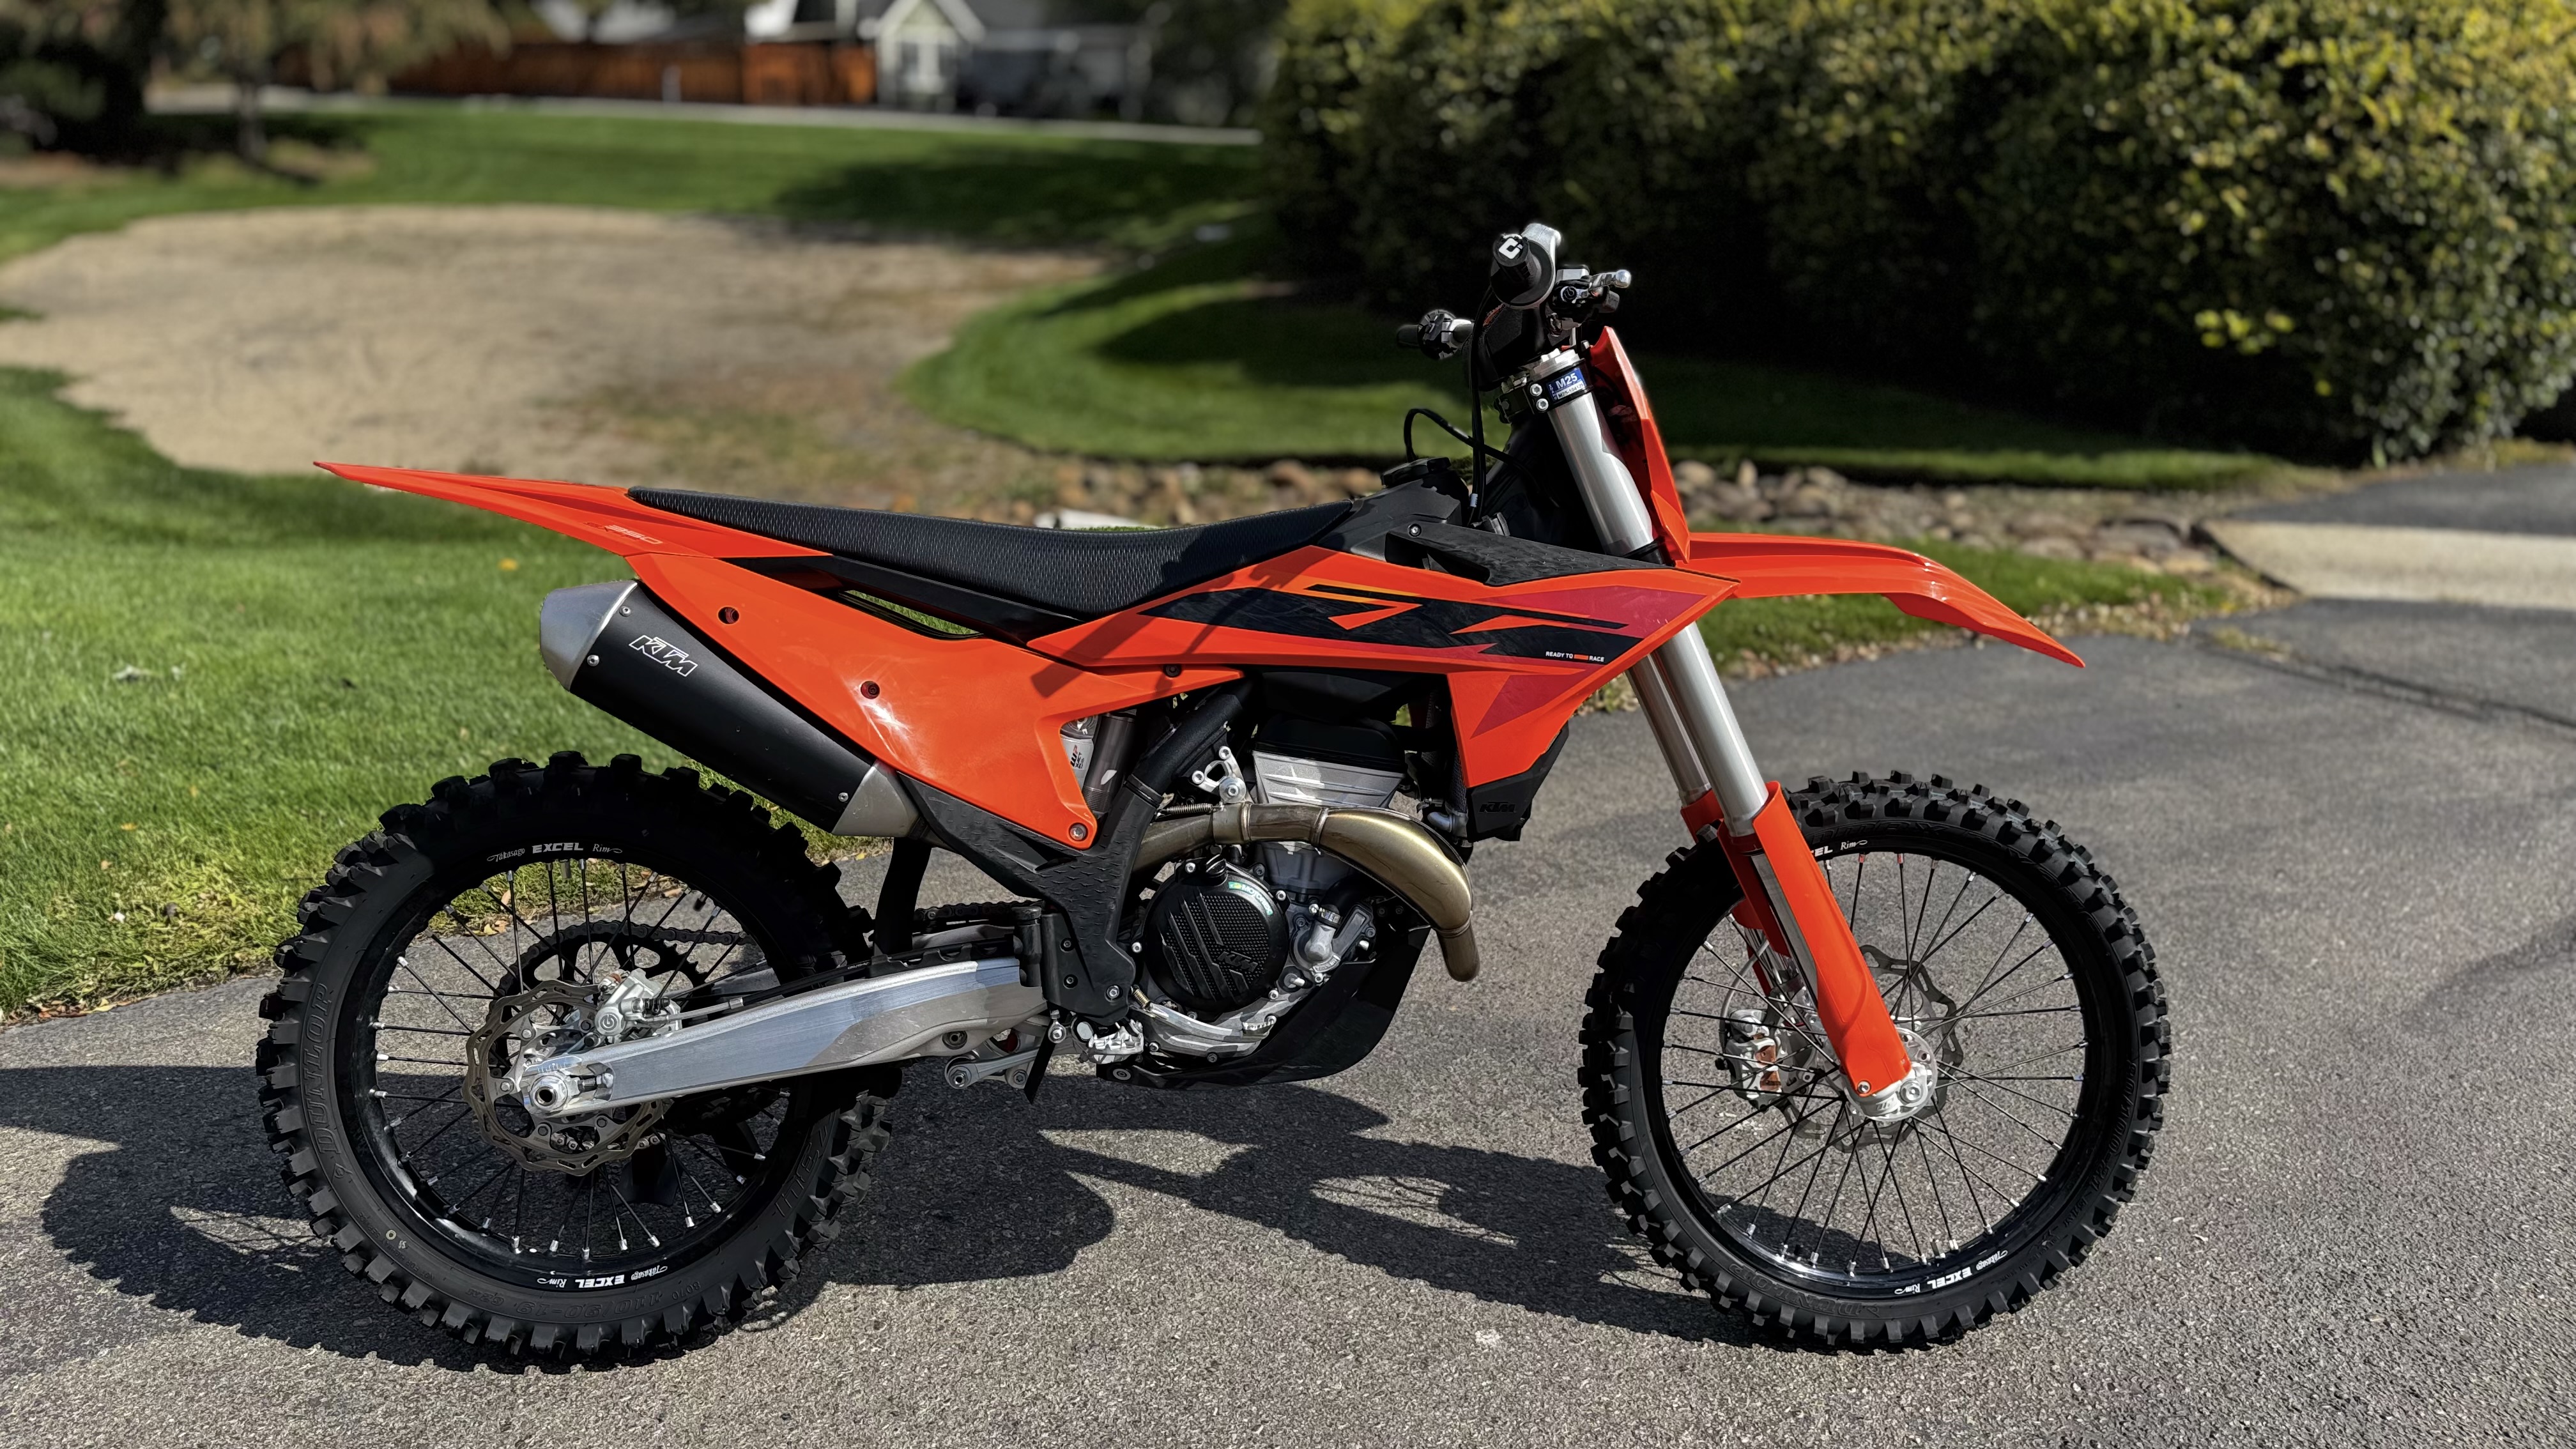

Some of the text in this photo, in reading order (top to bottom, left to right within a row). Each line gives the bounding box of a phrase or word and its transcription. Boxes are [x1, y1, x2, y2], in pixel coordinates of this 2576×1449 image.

[1556, 373, 1578, 389] M25
[629, 634, 698, 677] KTM
[1478, 801, 1516, 813] KTM
[532, 842, 584, 854] EXCEL
[592, 843, 623, 854] Rim
[1840, 839, 1867, 851] Rim
[1241, 884, 1273, 916] MOTOREX
[1217, 951, 1258, 972] KTM
[303, 983, 341, 1154] DUNLOP
[537, 1278, 567, 1289] Rim
[575, 1275, 625, 1289] EXCEL
[1927, 1266, 1972, 1289] EXCEL
[1728, 1263, 1862, 1317] DUNLOP
[1894, 1283, 1920, 1294] Rim
[516, 1292, 661, 1319] 110/90-19
